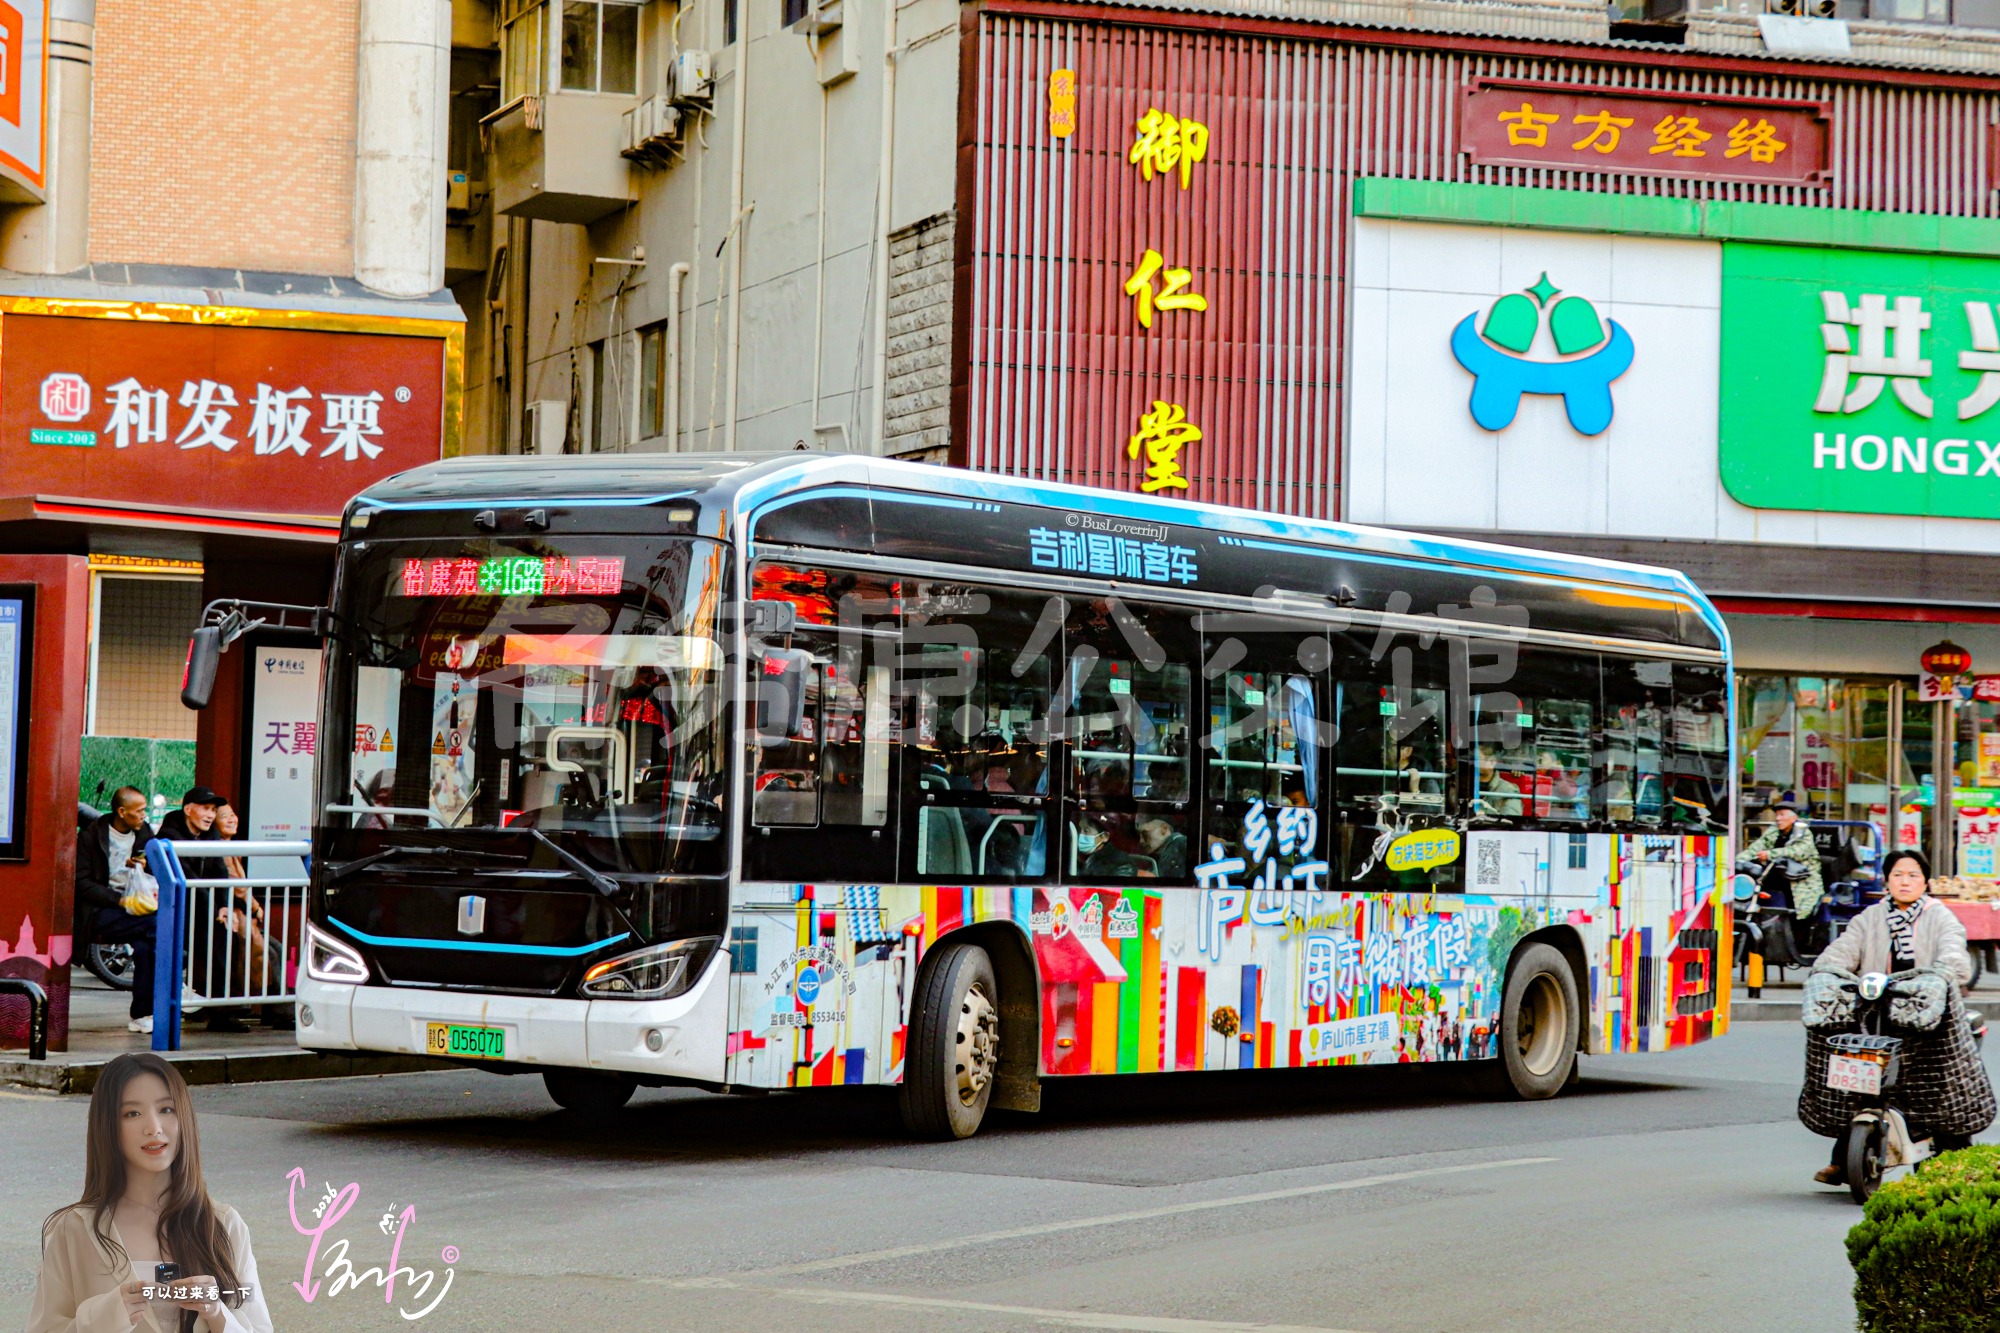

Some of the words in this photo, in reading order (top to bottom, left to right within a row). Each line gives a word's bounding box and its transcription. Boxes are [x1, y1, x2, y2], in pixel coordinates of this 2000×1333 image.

[1498, 103, 1787, 164] 古方经络
[1126, 108, 1209, 492] 御仁堂
[32, 431, 63, 443] Since
[67, 433, 96, 445] 2002
[104, 377, 384, 461] 和发板栗
[402, 559, 478, 596] 怡康苑
[502, 558, 543, 595] 16路
[1029, 526, 1199, 585] 吉利星际客车
[1244, 797, 1317, 863] 乡约
[1393, 839, 1455, 865] 方块猫艺术村
[1194, 843, 1329, 963] 庐山下
[1279, 904, 1362, 942] Summer
[1370, 883, 1437, 921] Travel
[764, 946, 857, 996] 九江市公共交通集团公司
[1302, 913, 1469, 1018] 周末微度假
[811, 1011, 846, 1023] 8553416
[1321, 1023, 1390, 1051] 庐山市星子镇
[1831, 1073, 1876, 1092] 08215
